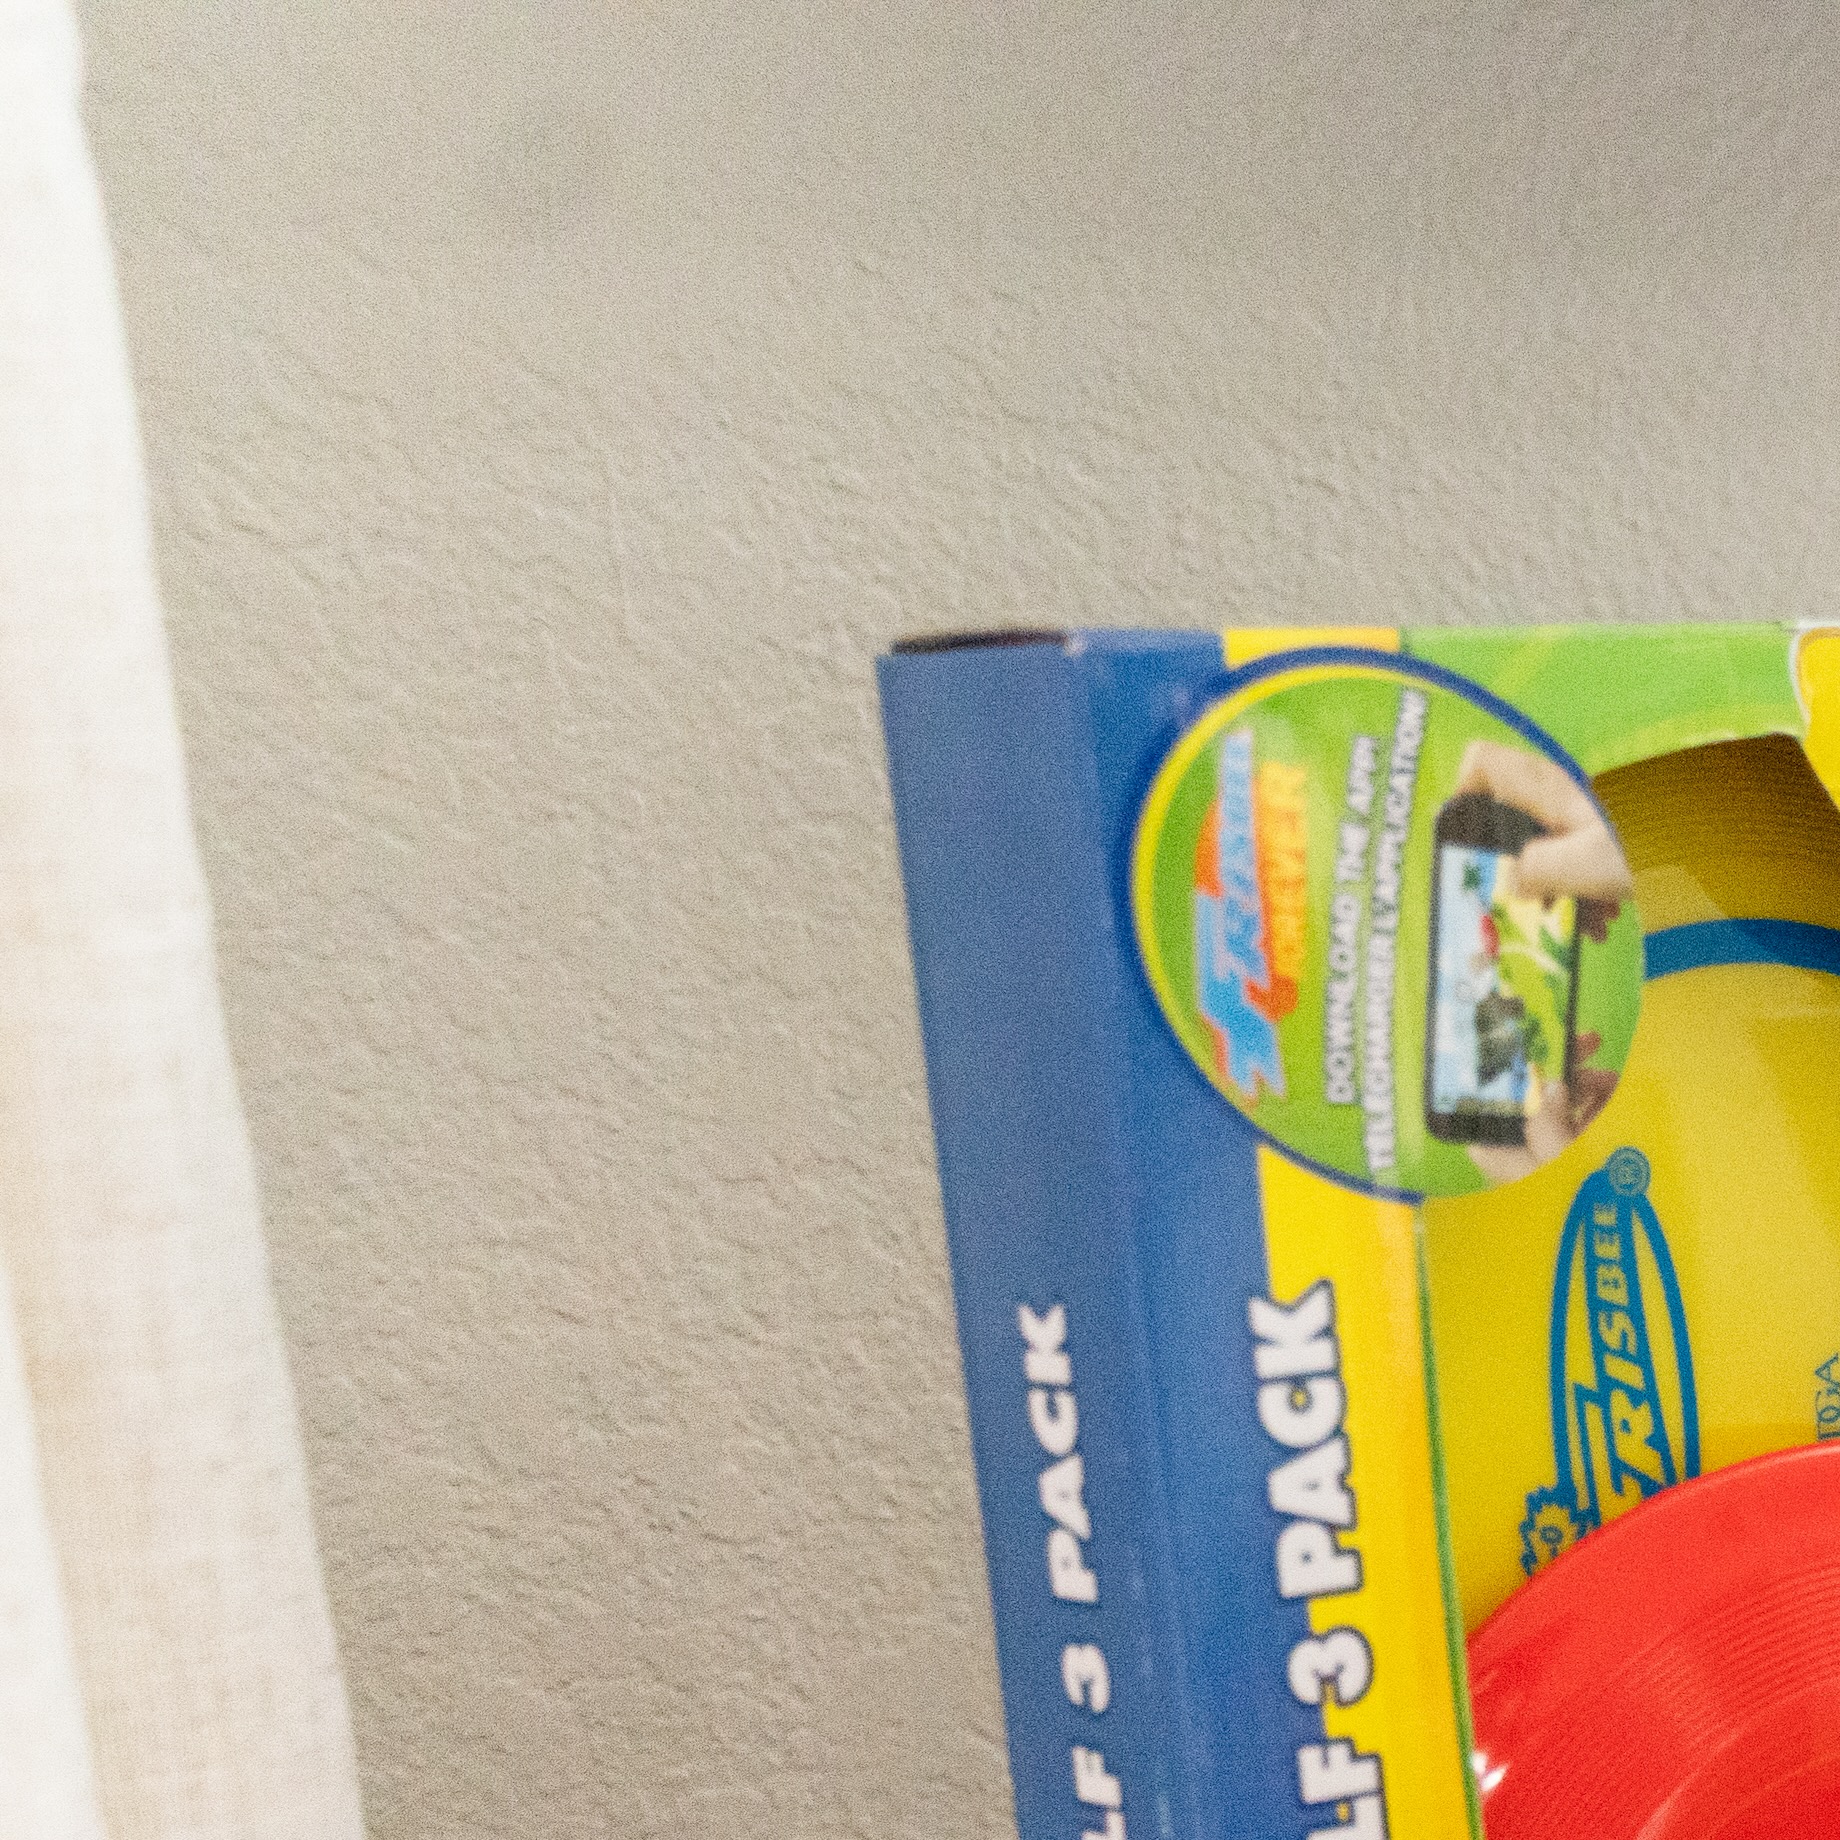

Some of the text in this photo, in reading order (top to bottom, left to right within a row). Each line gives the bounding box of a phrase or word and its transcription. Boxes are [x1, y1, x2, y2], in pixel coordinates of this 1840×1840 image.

[1335, 822, 1367, 880] THE
[1326, 893, 1362, 1104] DOWNLOAD
[1018, 1304, 1098, 1604] PACK
[1250, 1280, 1361, 1600] PACK
[1062, 1643, 1112, 1714] 3
[1287, 1626, 1375, 1706] 3
